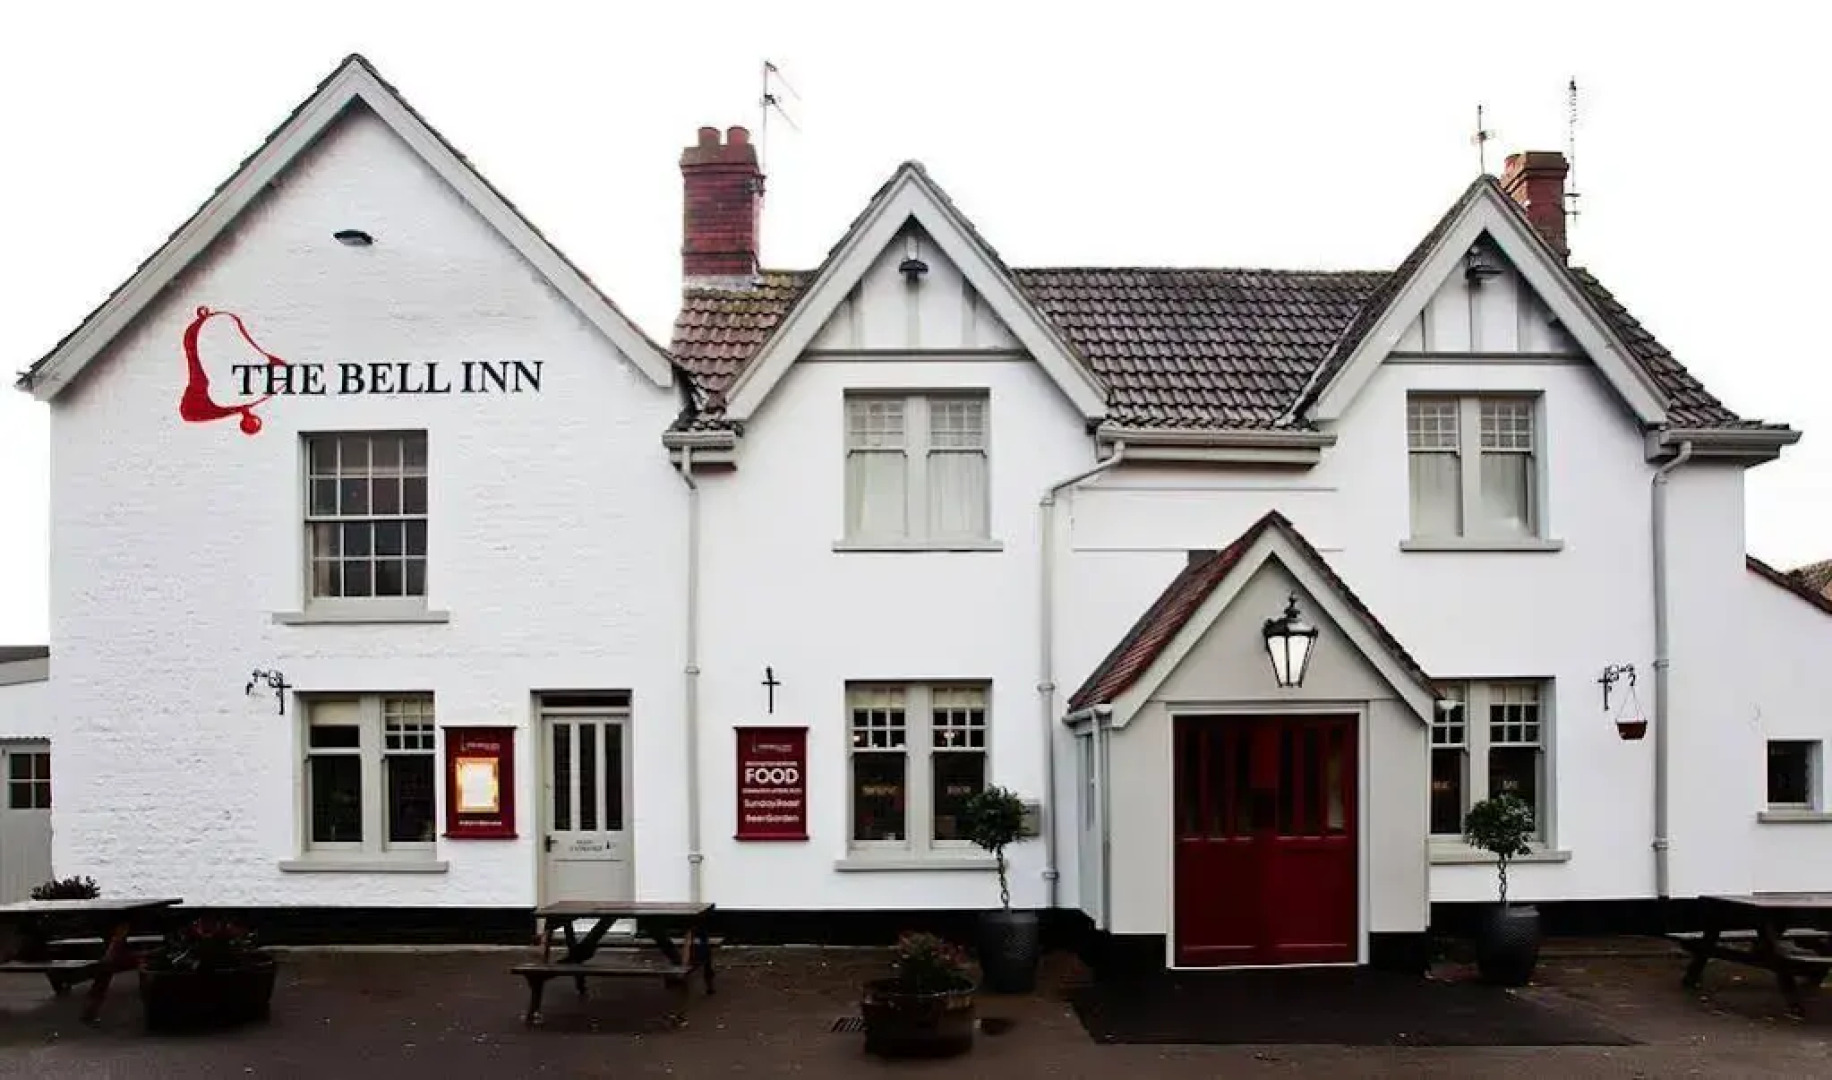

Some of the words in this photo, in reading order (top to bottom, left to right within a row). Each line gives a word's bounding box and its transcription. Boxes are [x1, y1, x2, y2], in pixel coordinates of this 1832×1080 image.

[232, 363, 326, 396] THE
[338, 362, 451, 394] BELL
[461, 361, 544, 393] INN
[745, 767, 800, 784] FOOD
